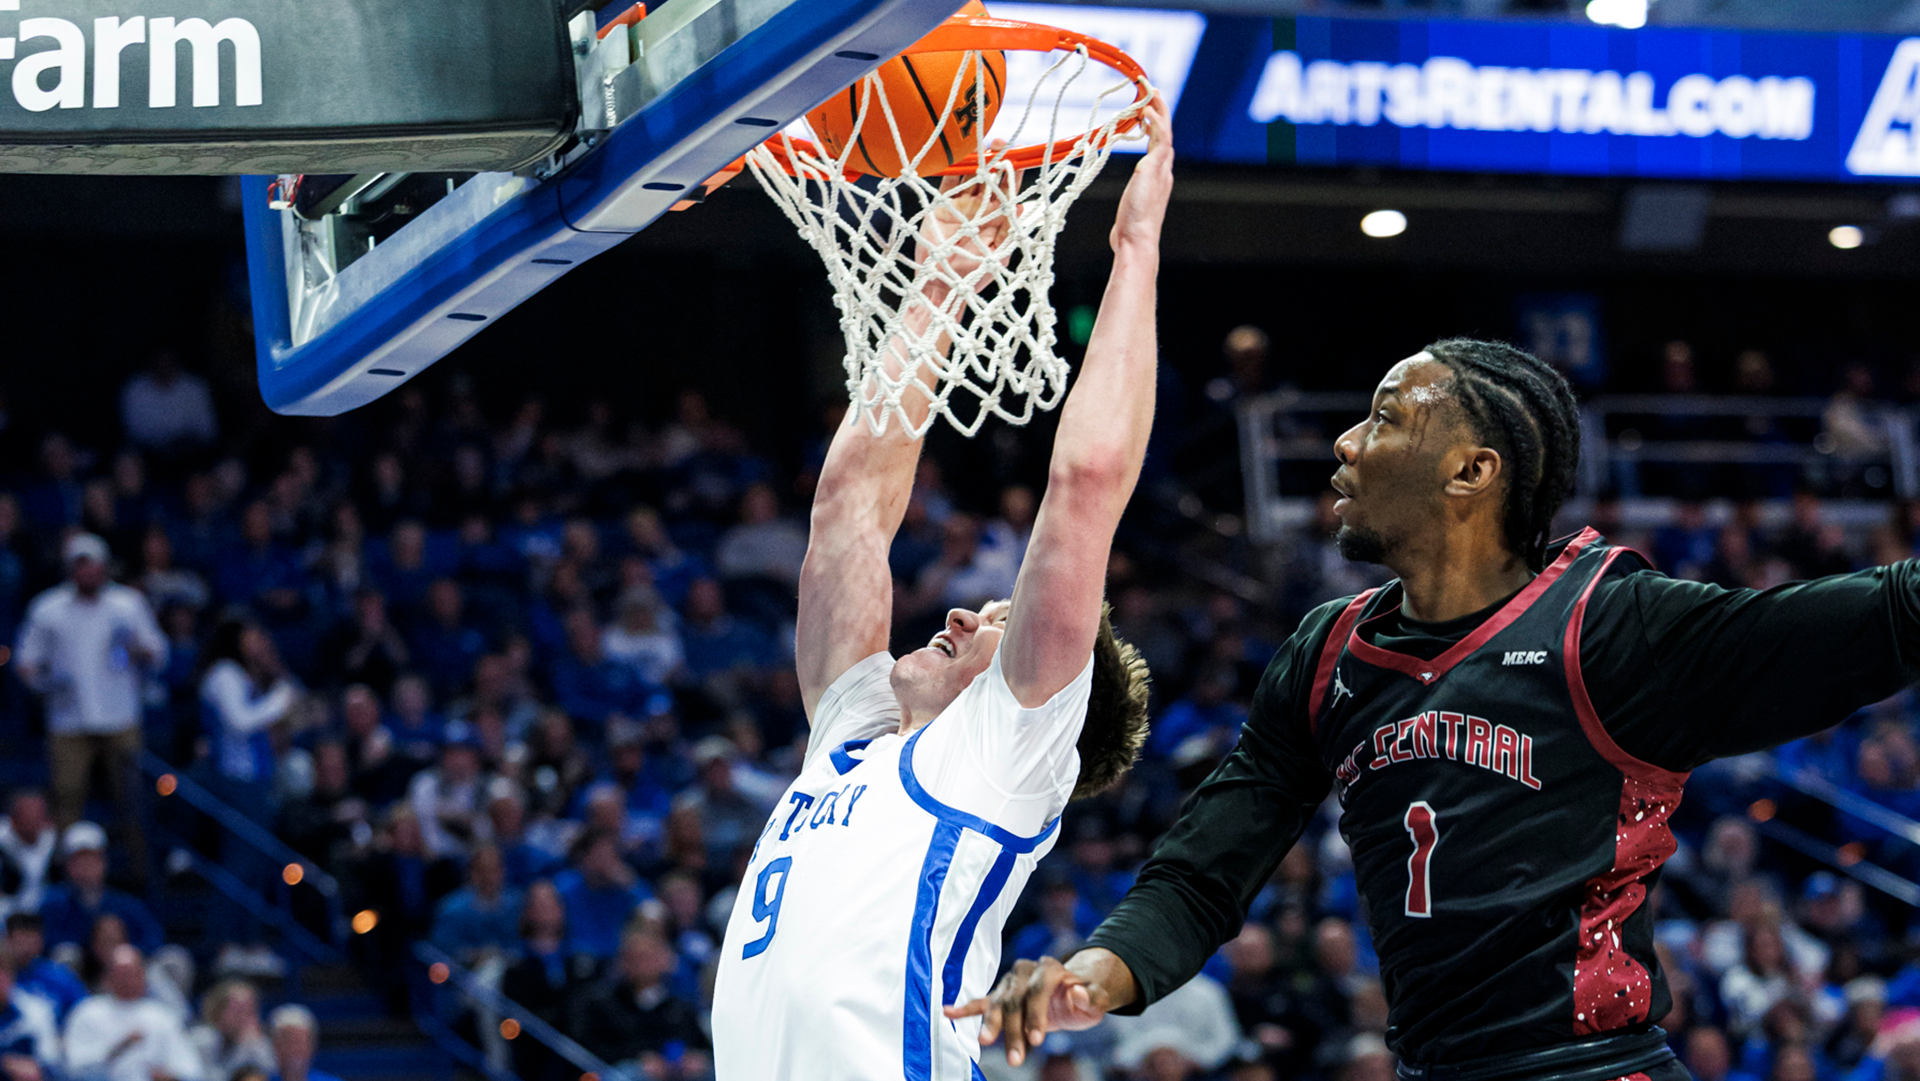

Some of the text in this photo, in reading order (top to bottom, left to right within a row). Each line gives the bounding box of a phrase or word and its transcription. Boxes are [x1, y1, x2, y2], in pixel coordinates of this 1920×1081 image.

[1501, 650, 1548, 666] MEAC
[1369, 710, 1542, 790] CENTRAL
[1404, 800, 1439, 918] 1
[742, 855, 793, 961] 9
